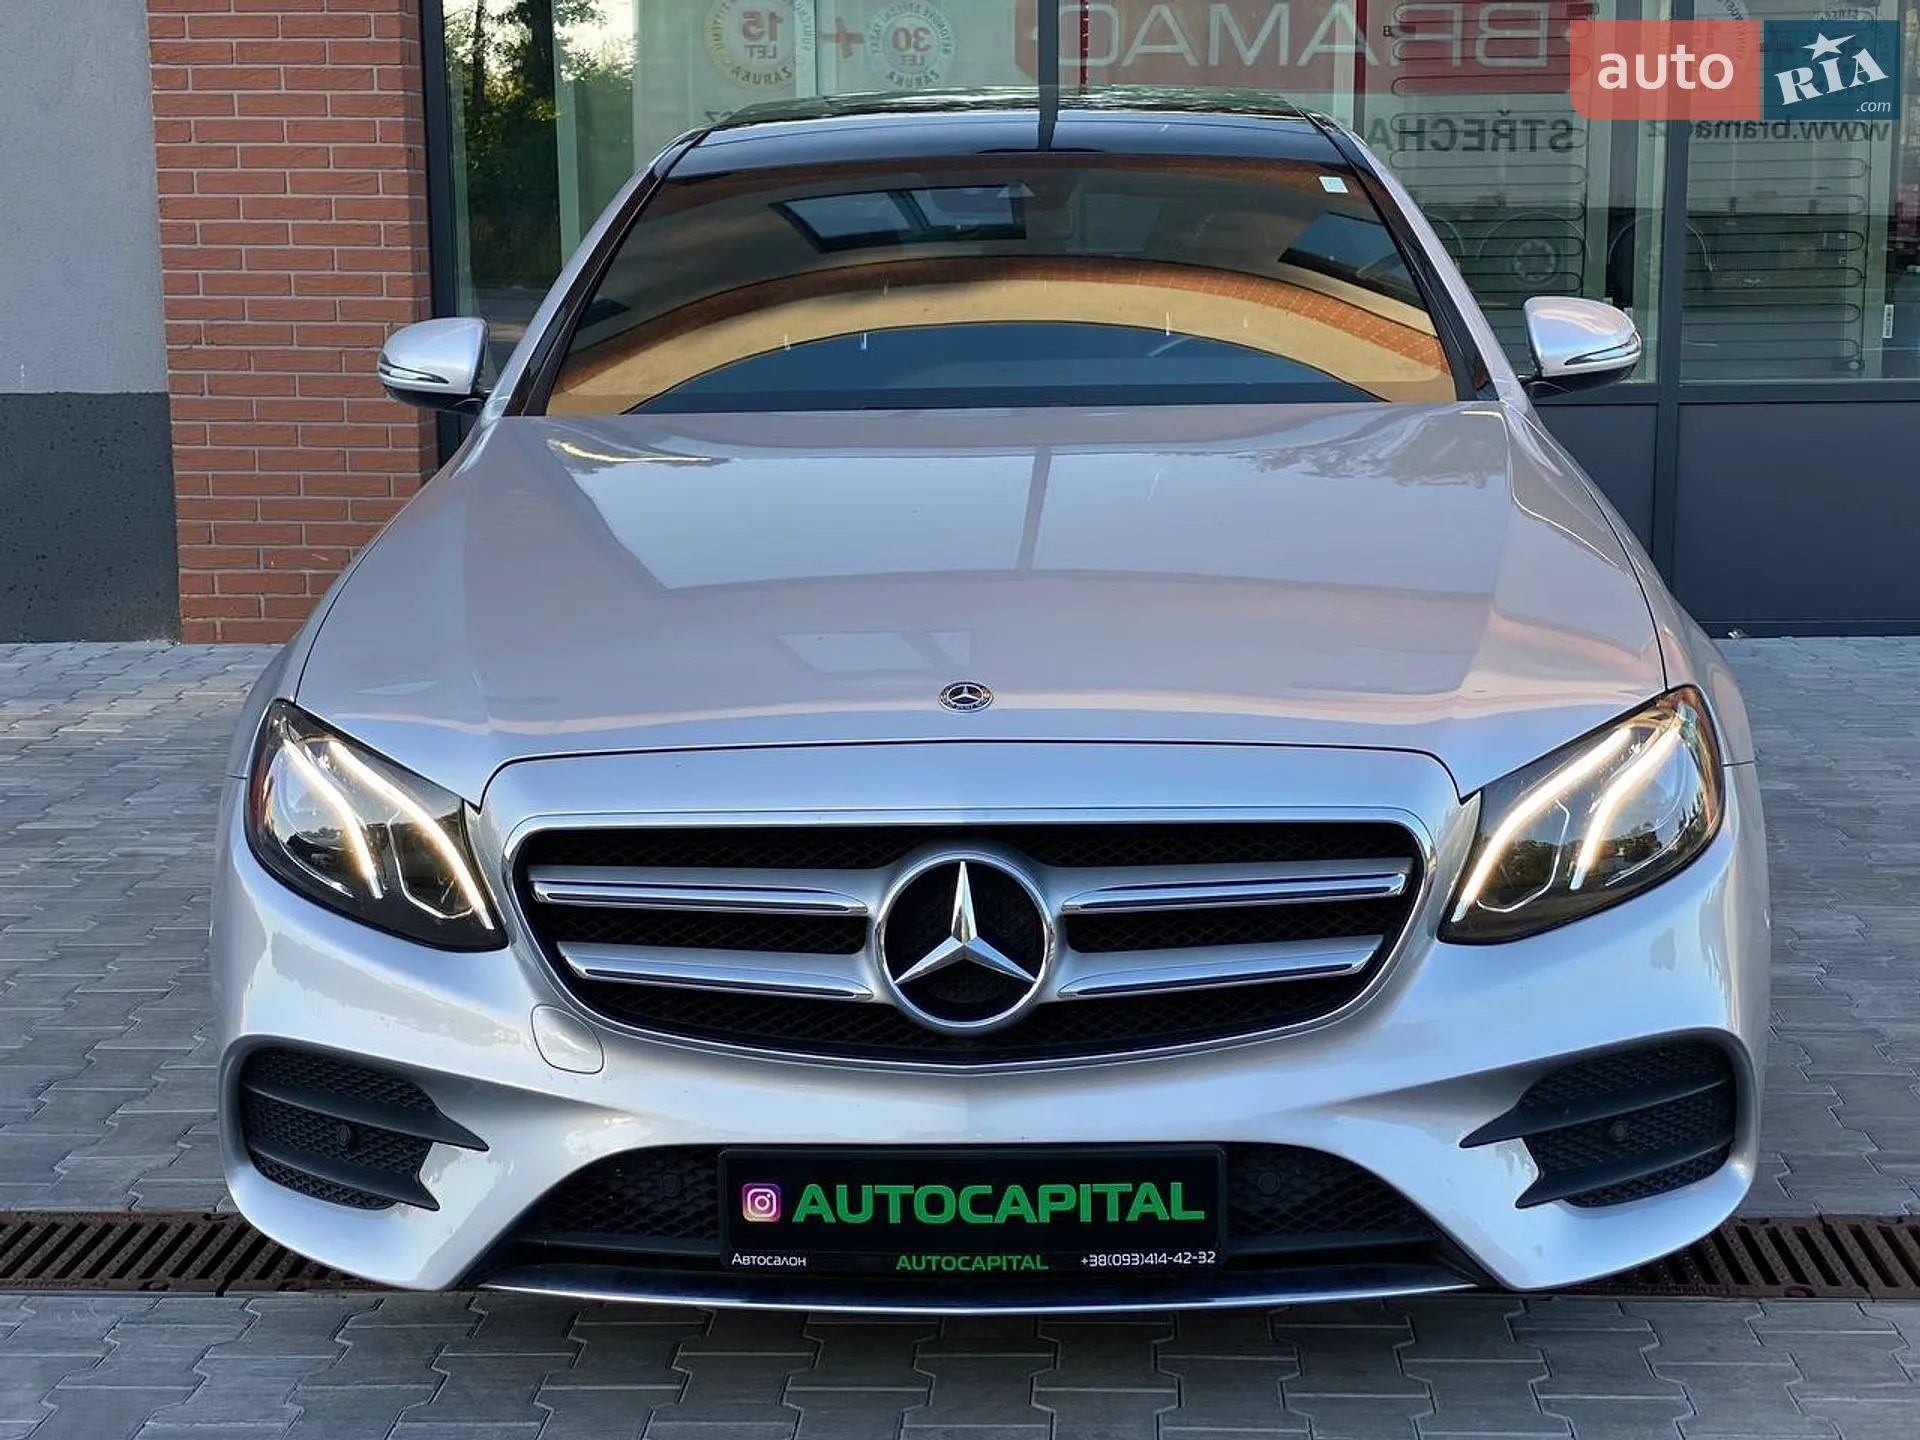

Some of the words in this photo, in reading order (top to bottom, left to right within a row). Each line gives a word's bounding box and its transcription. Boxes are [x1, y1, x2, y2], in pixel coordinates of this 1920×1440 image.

[792, 1182, 1205, 1224] AUTOCAPITAL
[731, 1252, 807, 1267] Автосалон
[896, 1253, 1049, 1272] AUTOCAPITAL
[1081, 1251, 1216, 1267] +38(093)414-42-32
